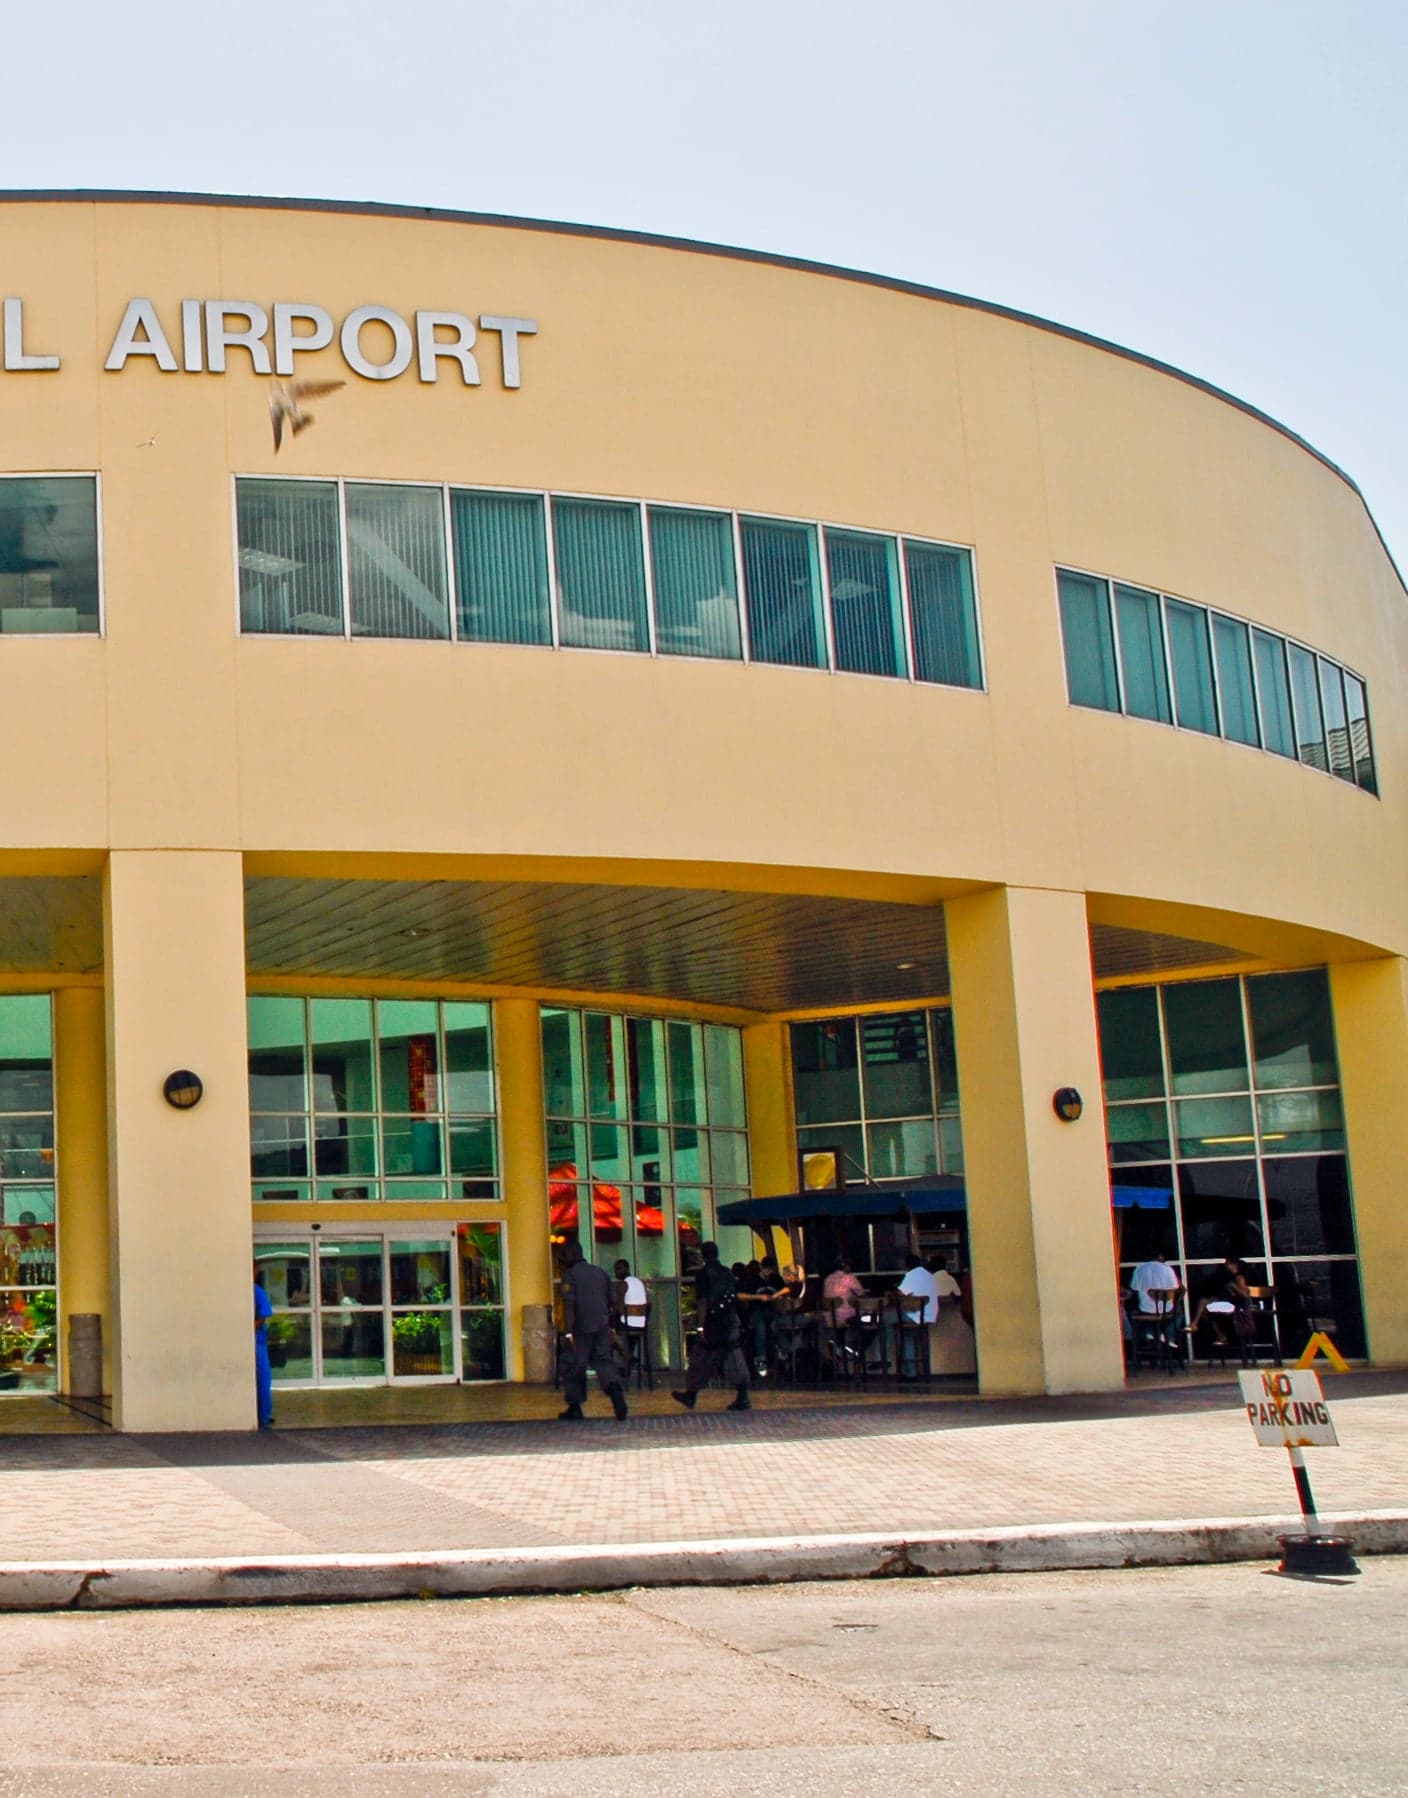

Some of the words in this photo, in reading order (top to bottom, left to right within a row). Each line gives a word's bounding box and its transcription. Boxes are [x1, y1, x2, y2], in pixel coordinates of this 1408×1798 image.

[103, 297, 537, 390] AIRPORT
[1261, 1374, 1292, 1397] NO
[1247, 1402, 1328, 1426] PARKING
